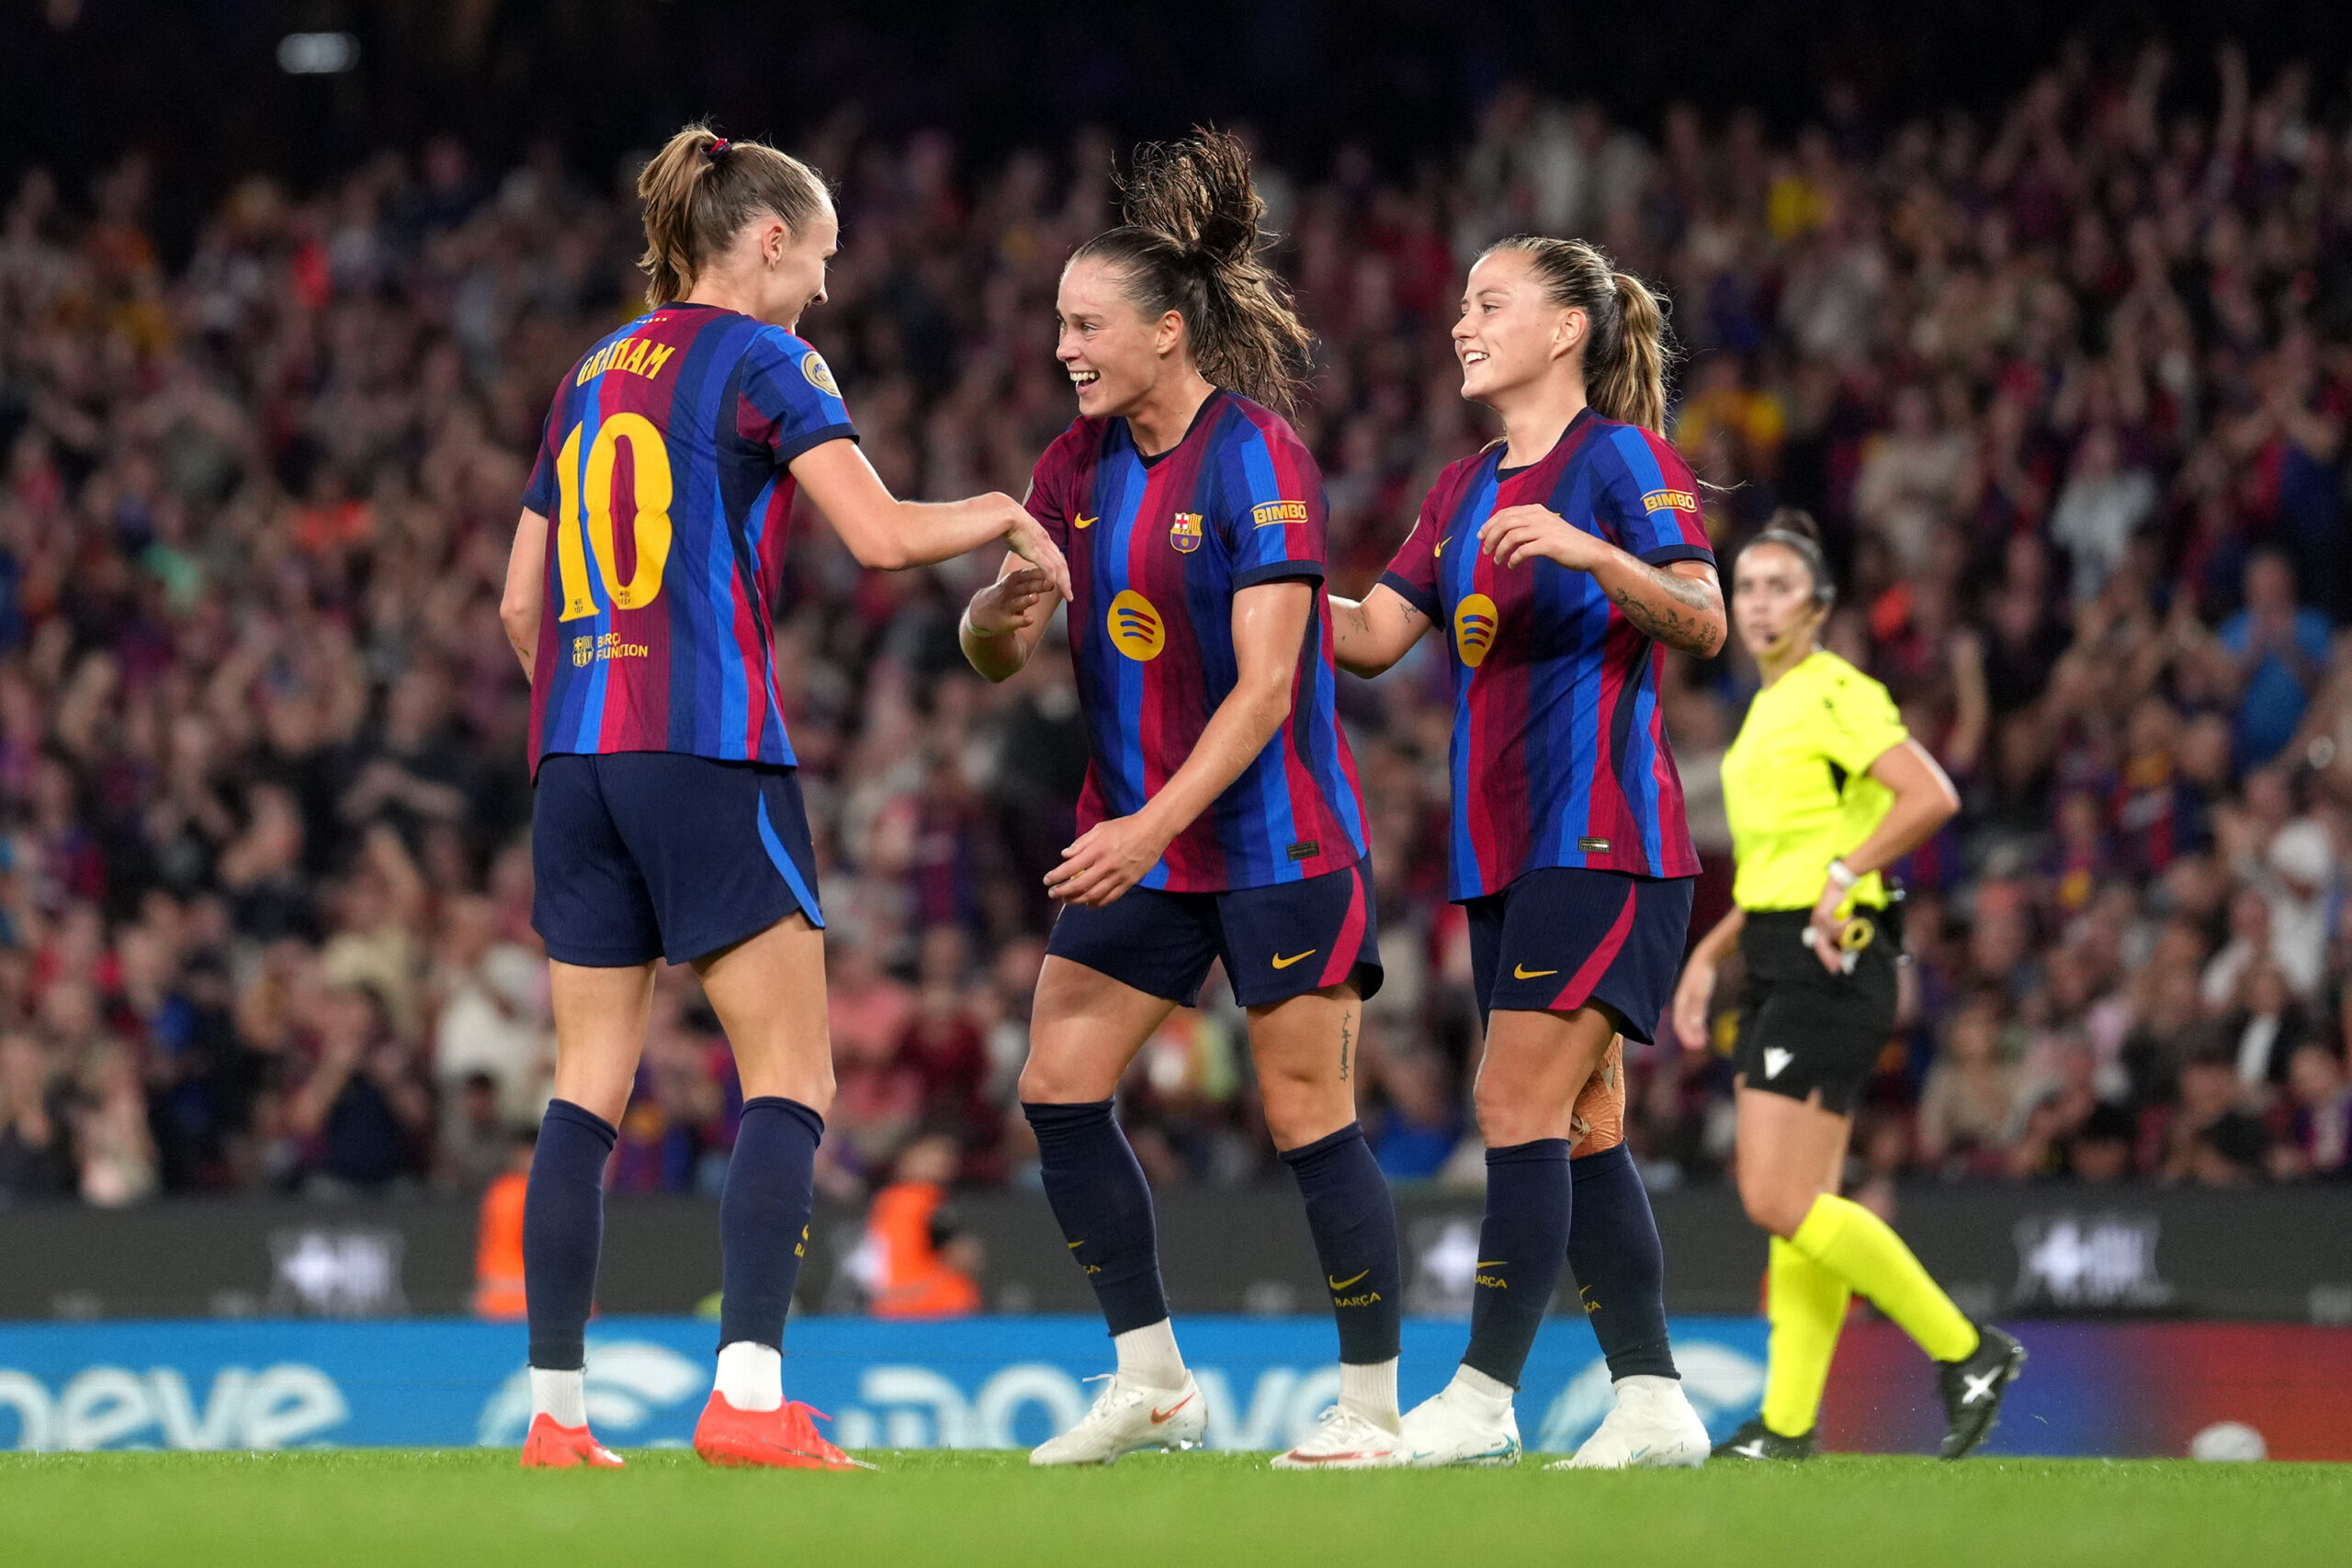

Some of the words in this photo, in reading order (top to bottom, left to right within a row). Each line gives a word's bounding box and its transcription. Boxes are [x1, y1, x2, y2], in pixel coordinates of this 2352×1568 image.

[1643, 493, 1695, 511] BIMBO
[557, 412, 673, 623] 10
[1253, 504, 1306, 525] BIMBO
[1475, 1275, 1508, 1289] ARÇA
[1335, 1292, 1382, 1307] BARÇA
